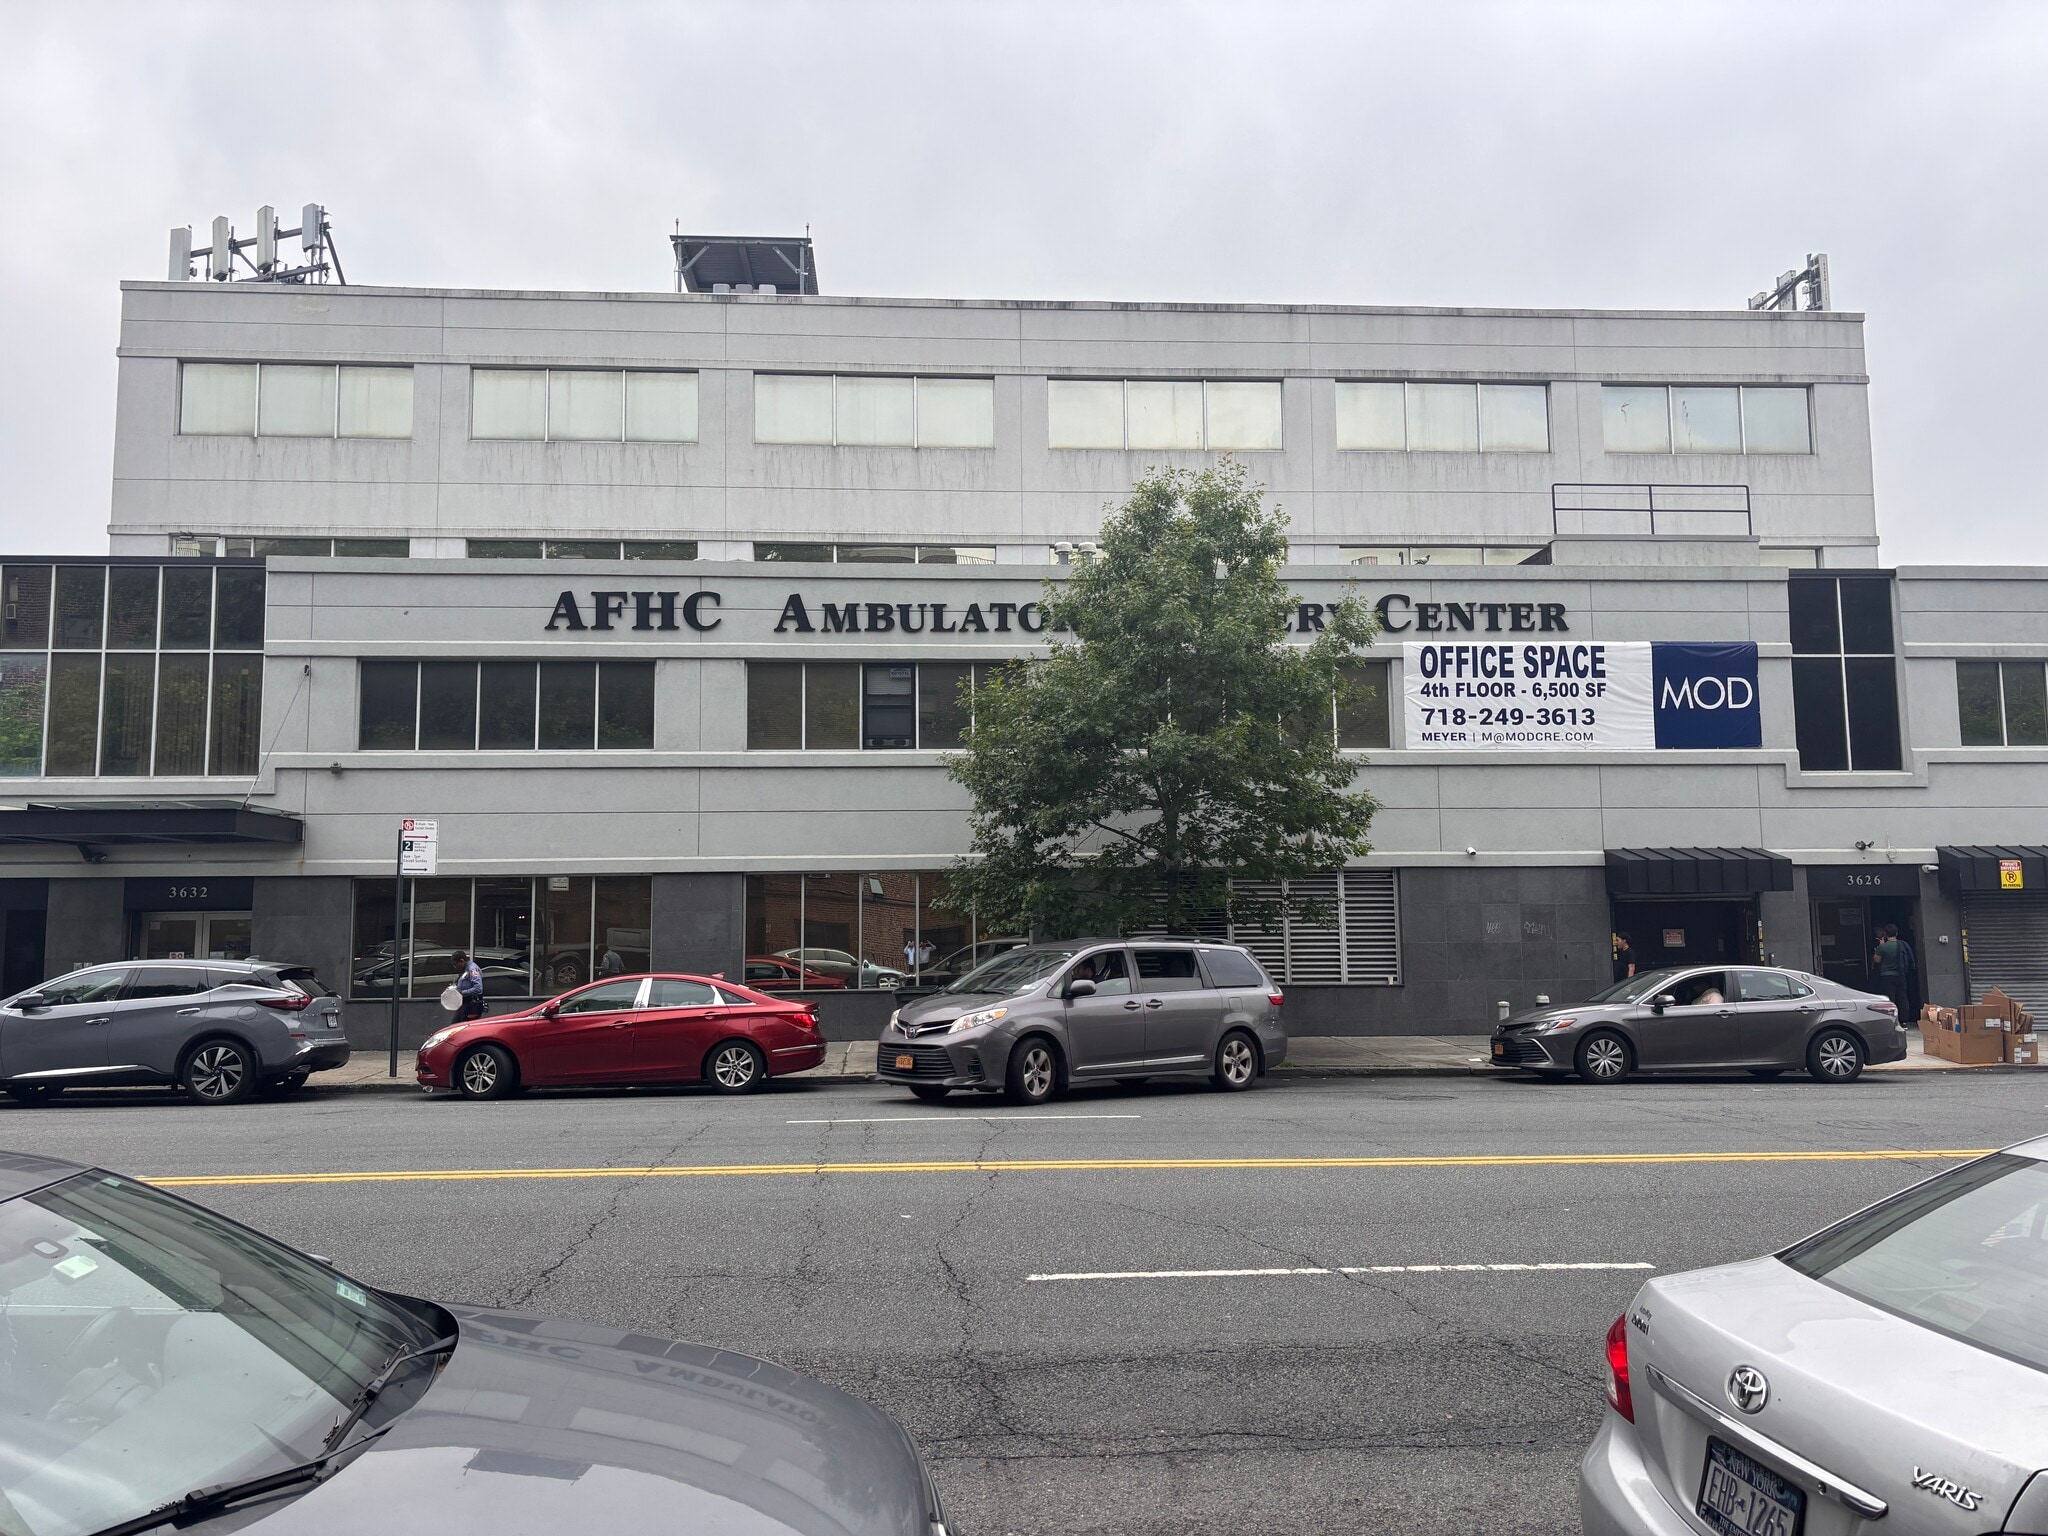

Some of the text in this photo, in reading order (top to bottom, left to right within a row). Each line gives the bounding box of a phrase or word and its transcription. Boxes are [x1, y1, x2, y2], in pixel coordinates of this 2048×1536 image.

[545, 591, 722, 631] AFHC
[773, 593, 1079, 634] AMBULATO
[1375, 593, 1568, 632] CENTER
[1420, 645, 1606, 679] OFFICE SPACE
[1420, 682, 1450, 698] 4th
[1455, 682, 1516, 698] FLOOR
[1532, 682, 1580, 701] 6,500
[1585, 682, 1607, 698] SF
[1660, 676, 1753, 710] MOD
[1421, 708, 1596, 726] 718-249-3613
[1421, 732, 1467, 741] MEYER
[1482, 732, 1594, 743] M@MODCRE.COM
[405, 842, 411, 850] 2
[1847, 875, 1881, 886] 3626
[169, 887, 208, 898] 3632
[1727, 1456, 1752, 1482] NEW
[1751, 1469, 1778, 1501] YORK
[1707, 1465, 1739, 1516] EHB
